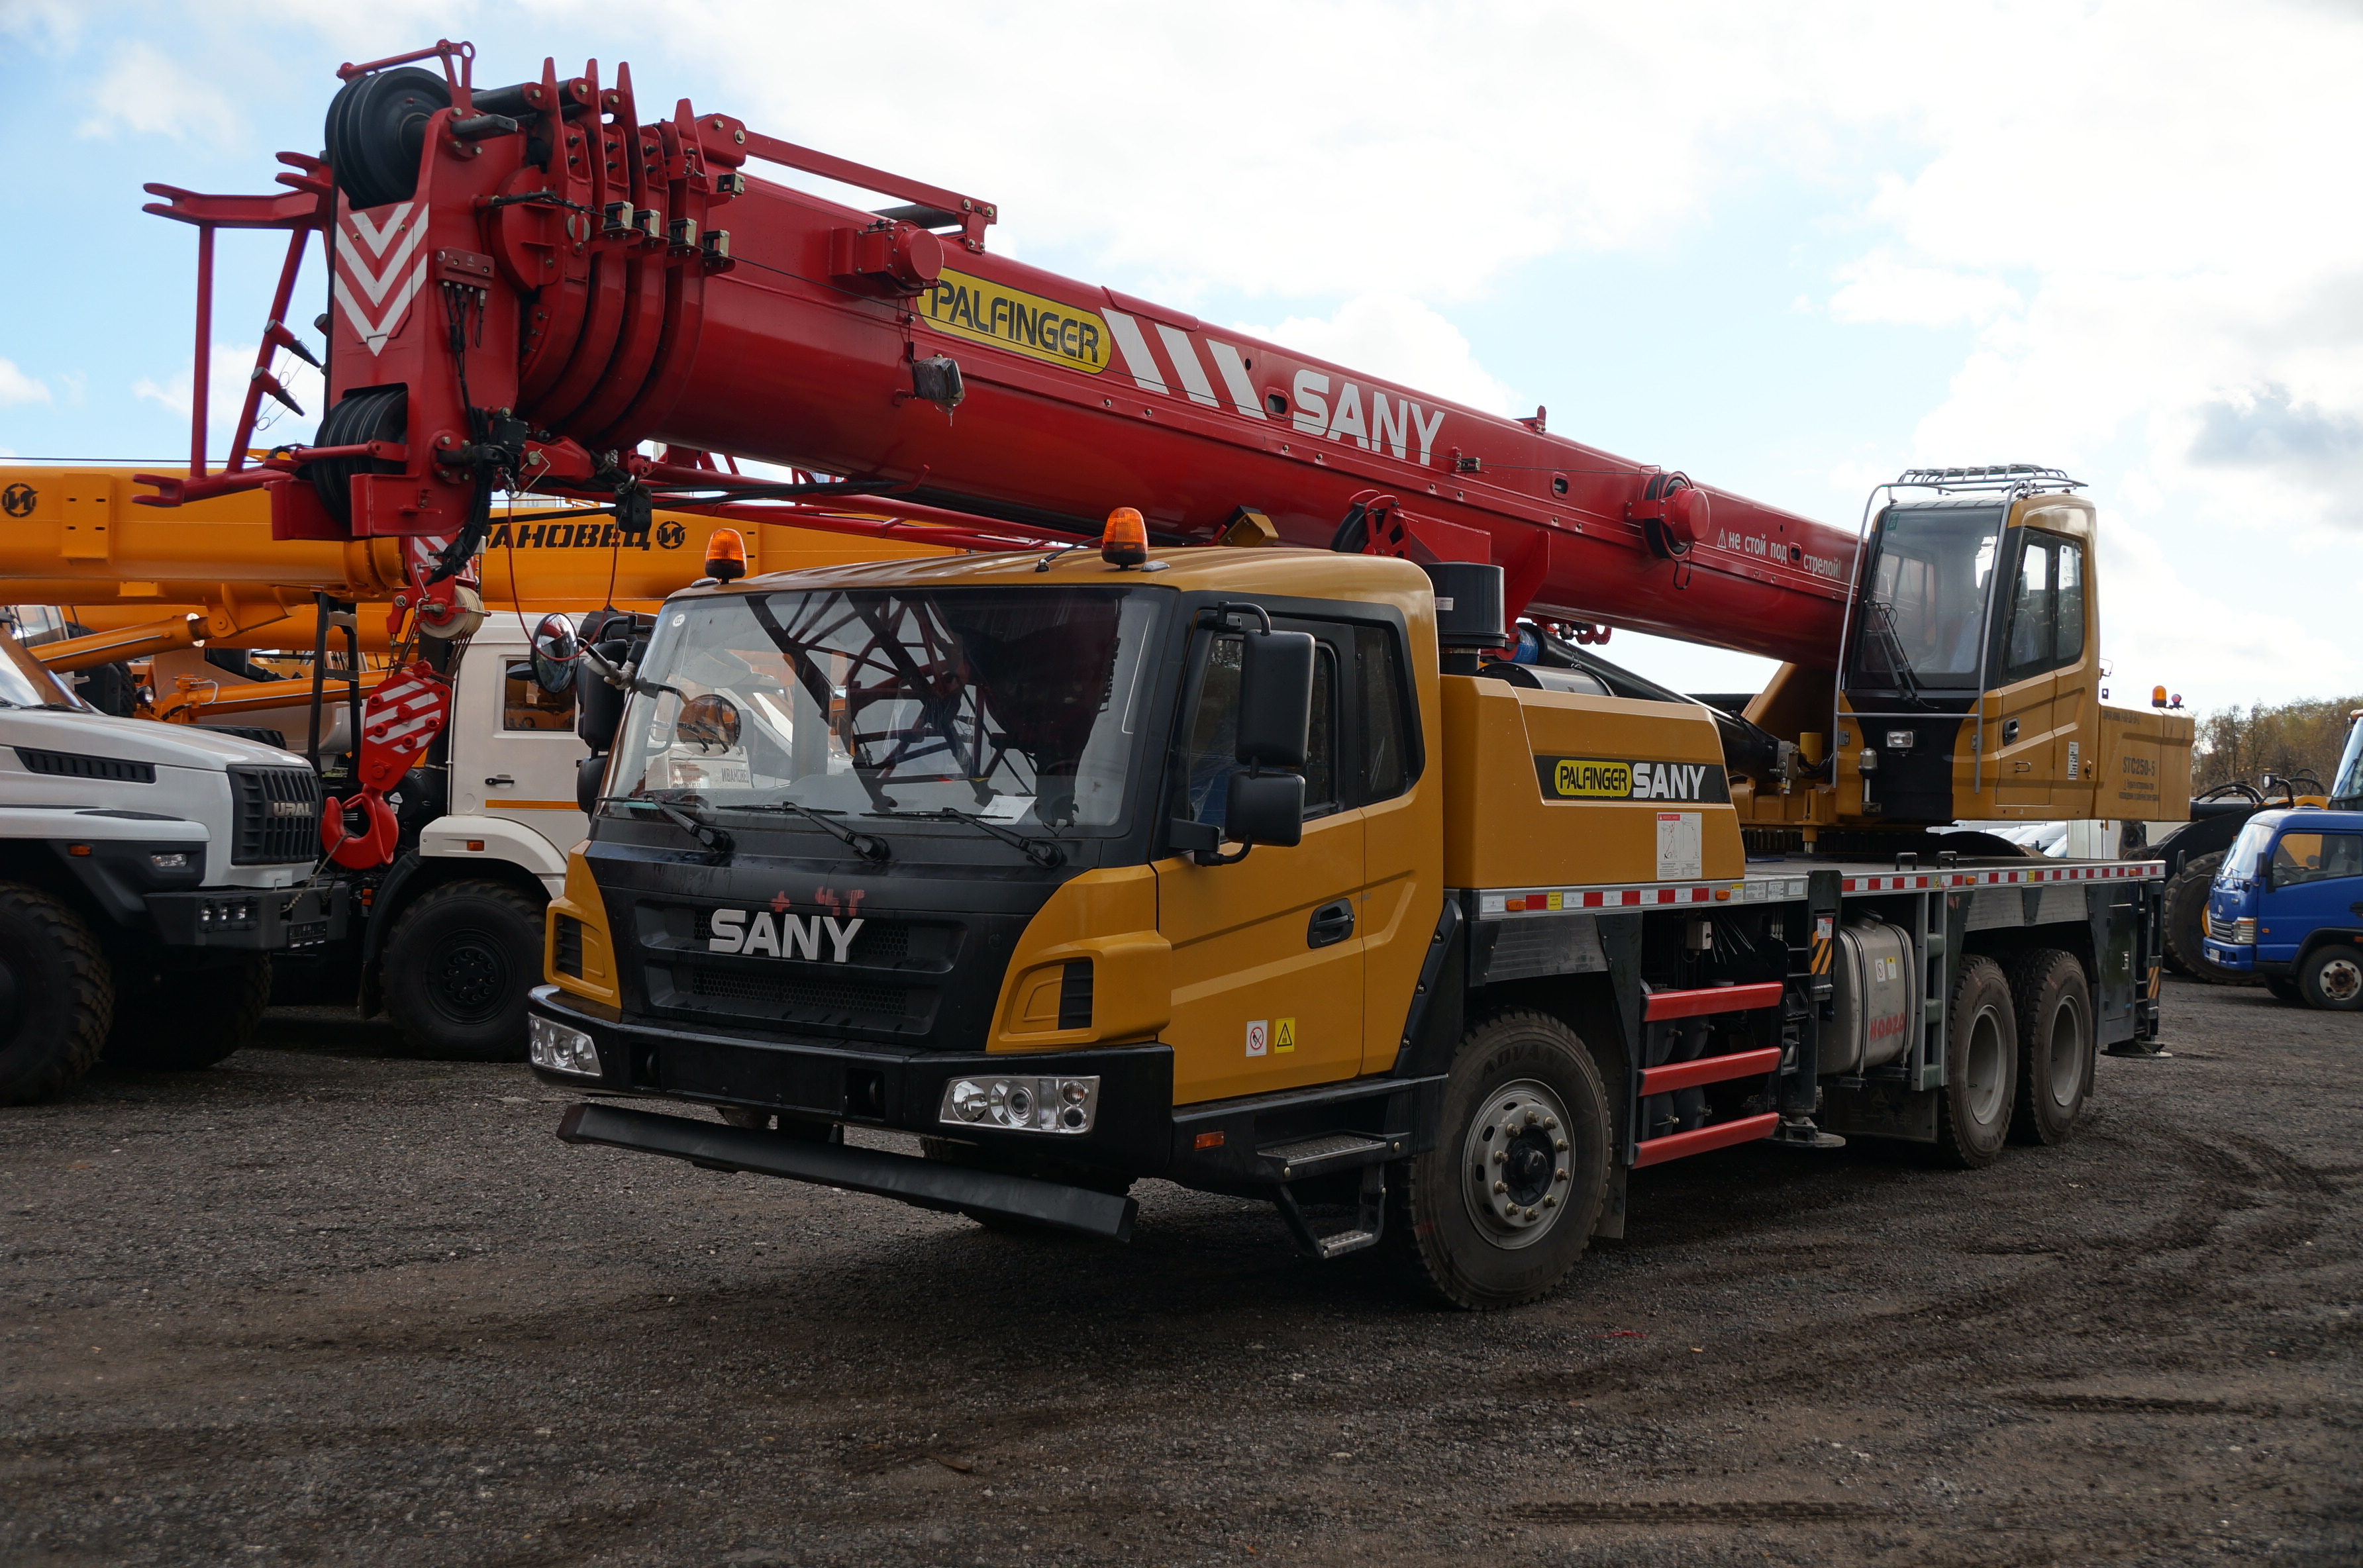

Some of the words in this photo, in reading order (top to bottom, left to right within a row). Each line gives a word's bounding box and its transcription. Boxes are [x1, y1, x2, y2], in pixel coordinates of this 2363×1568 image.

[931, 280, 1099, 364] PALFINGER
[1293, 369, 1445, 466] SANY
[486, 524, 651, 550] АНОВЕЦ
[1728, 532, 1740, 550] не
[1744, 533, 1766, 556] стой
[1770, 542, 1787, 564] под
[1803, 554, 1841, 578] стрелой!
[1560, 766, 1627, 791] PALFINGER
[1633, 763, 1706, 799] SANY
[2123, 756, 2156, 776] STC250-5
[274, 803, 313, 816] URAL
[709, 908, 865, 963] SANY
